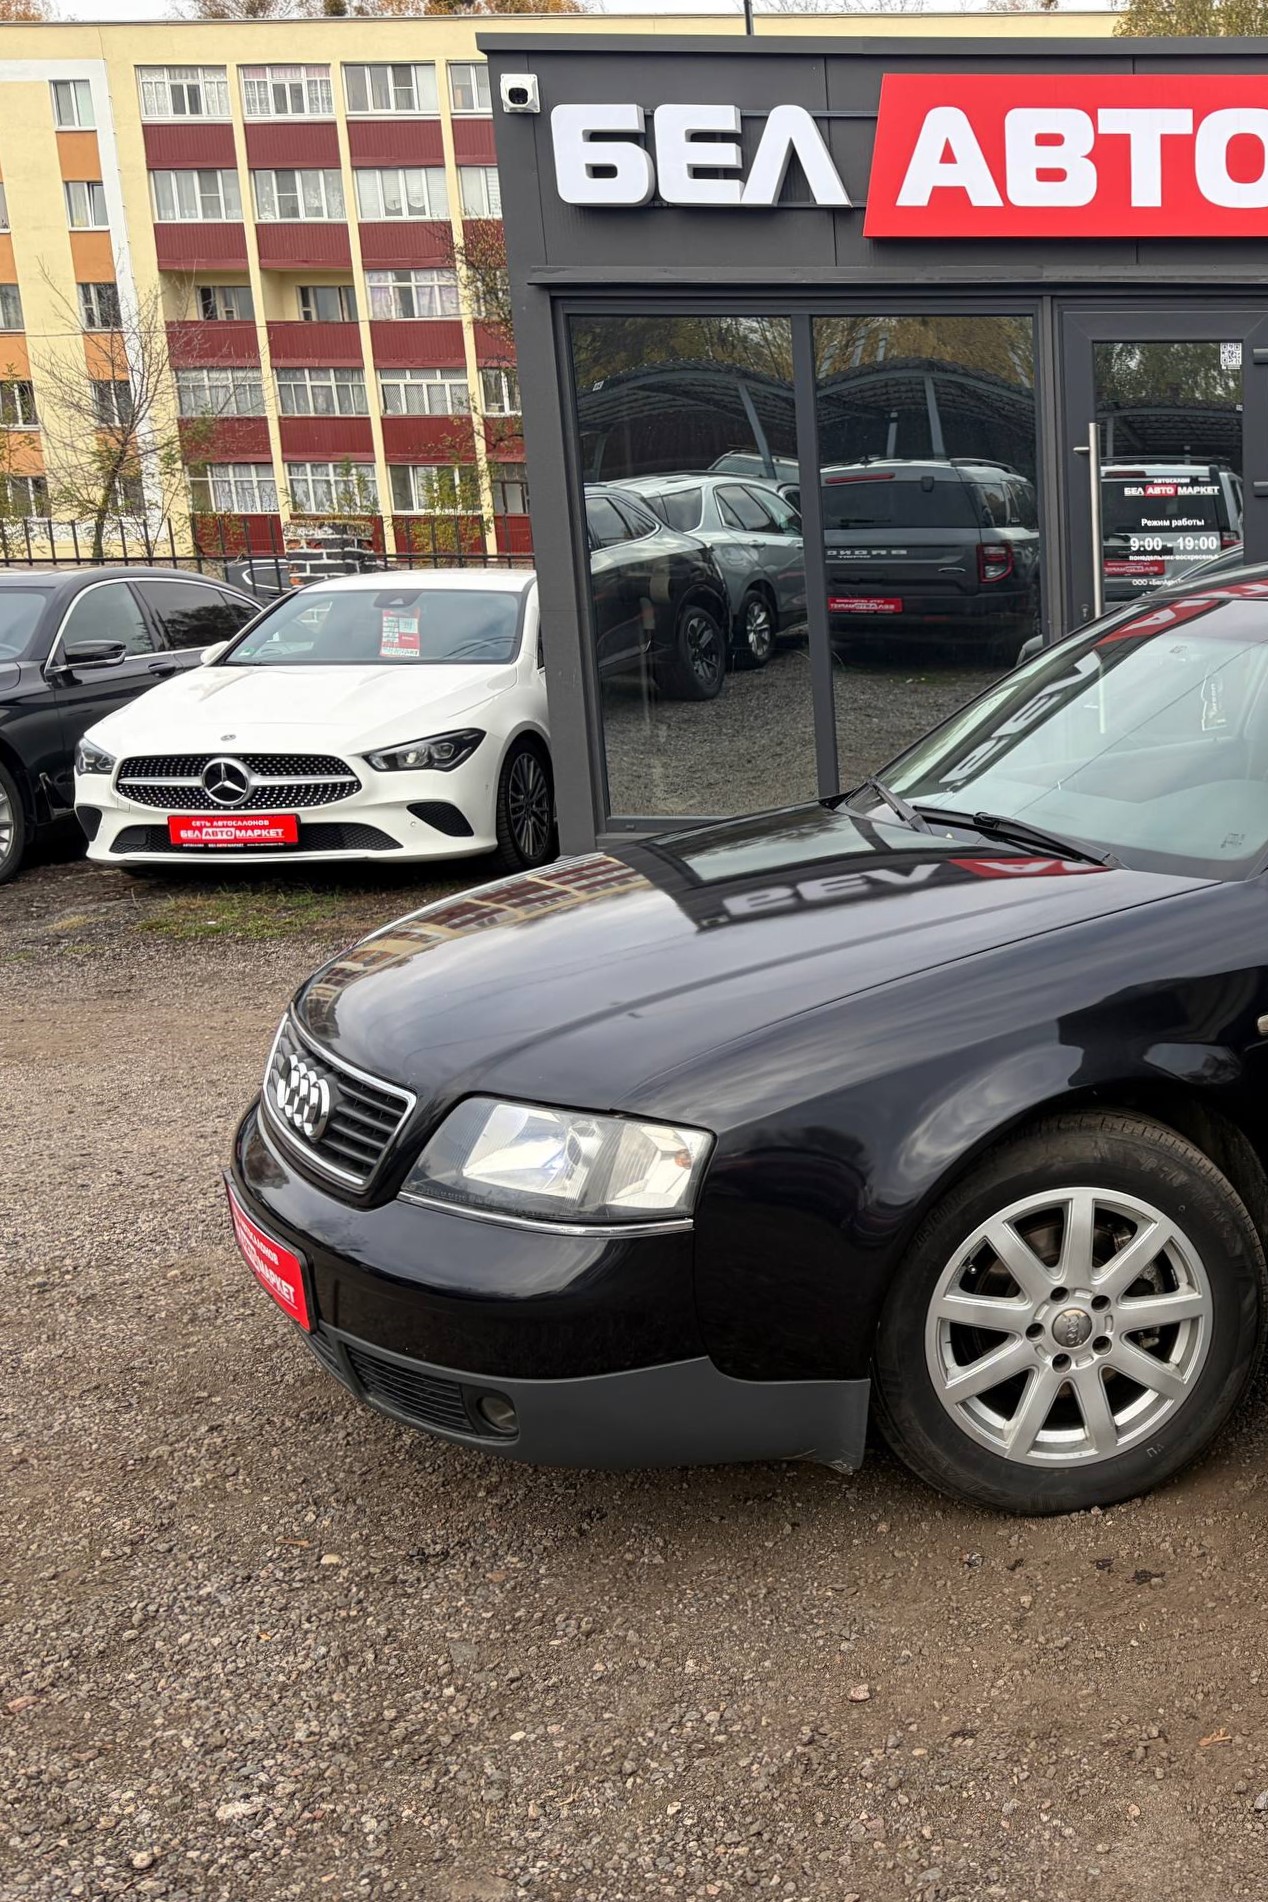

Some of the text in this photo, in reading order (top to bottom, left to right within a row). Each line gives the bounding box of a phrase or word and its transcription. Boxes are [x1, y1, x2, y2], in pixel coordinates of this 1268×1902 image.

[550, 103, 853, 207] БЕЛ
[1124, 486, 1220, 496] БЕЛ АВТО МАРКЕТ
[1141, 518, 1205, 528] Режим работы
[1130, 537, 1162, 551] 9:00
[1176, 536, 1217, 550] 19:00
[212, 819, 270, 827] АВТОСАЛОНОВ
[180, 828, 284, 839] БЕЛ АВТО МАРКЕТ
